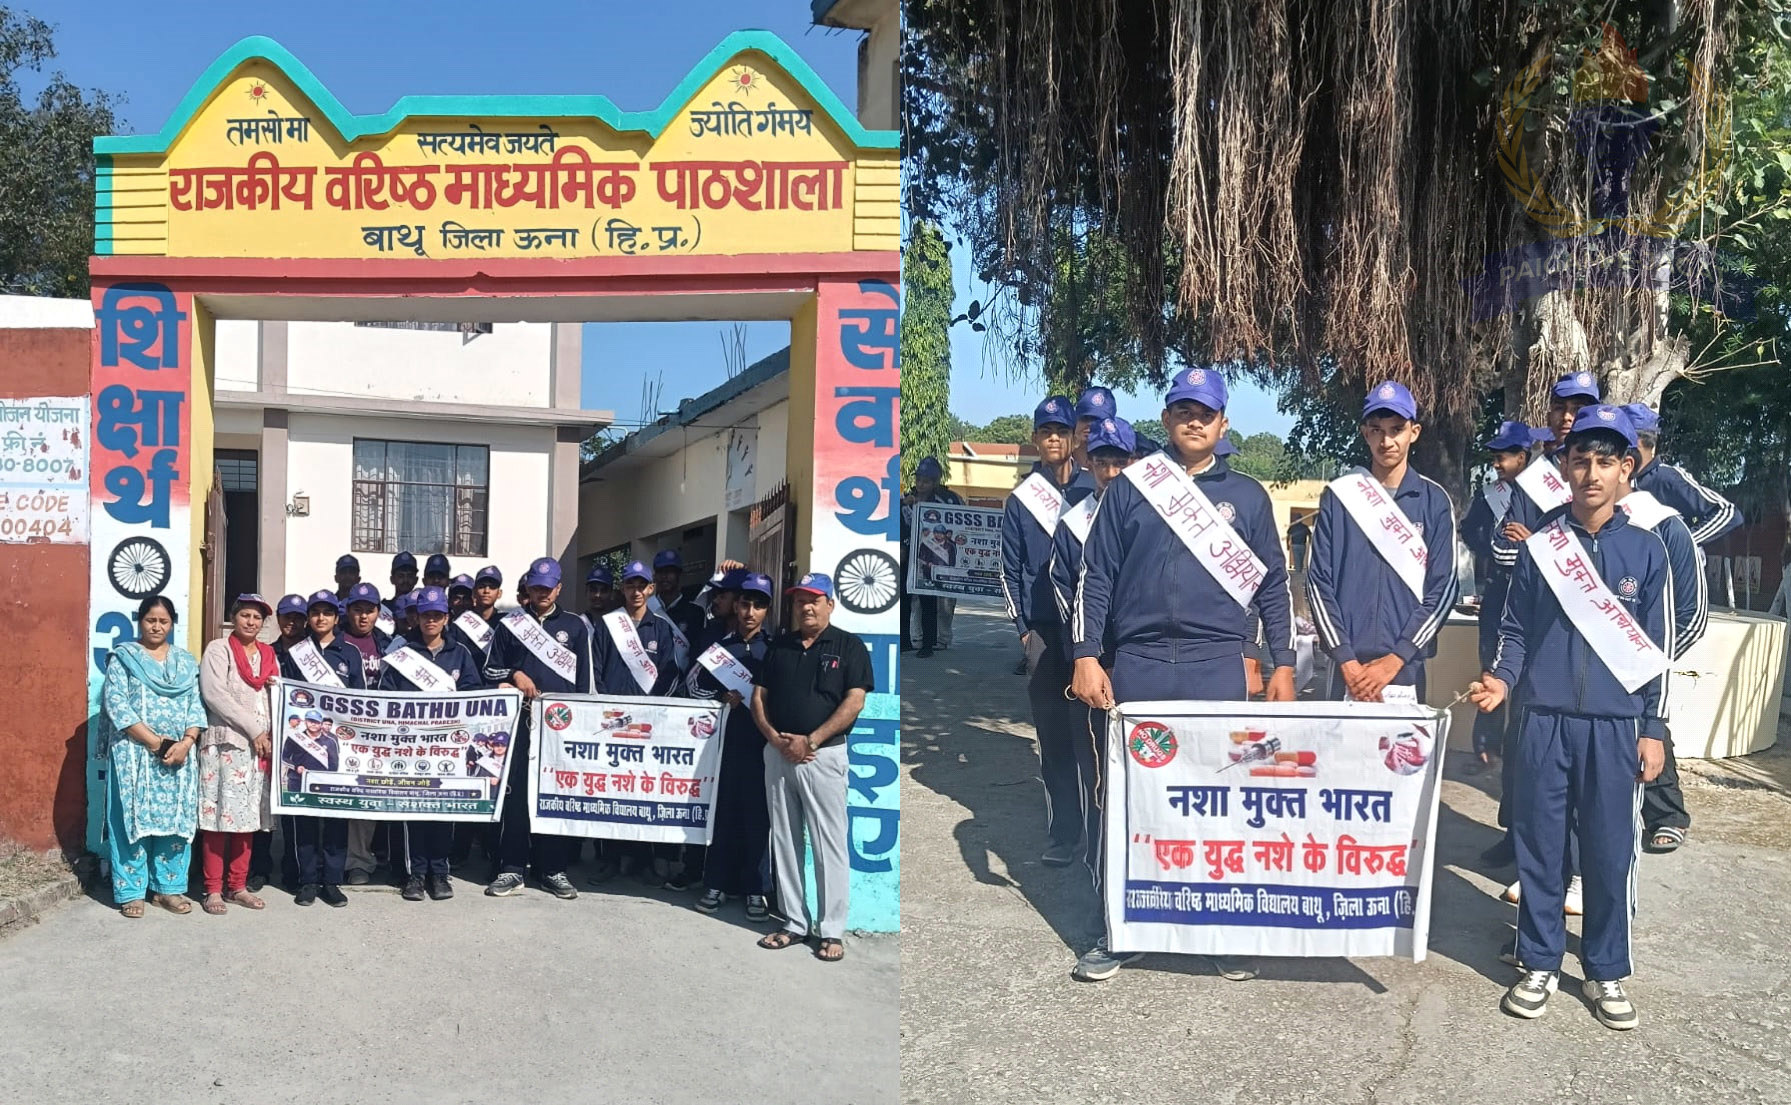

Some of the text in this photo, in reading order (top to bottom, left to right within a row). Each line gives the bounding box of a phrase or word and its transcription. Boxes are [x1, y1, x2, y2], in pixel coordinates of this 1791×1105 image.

[417, 124, 560, 156] सत्यमेव जयते
[169, 145, 850, 211] राजकीय वरिष्ठ माध्यमिक पाठशाला
[361, 224, 431, 258] बाथू
[439, 220, 505, 250] जिला
[513, 228, 580, 251] ऊना
[16, 495, 70, 513] CODE
[1357, 477, 1387, 507] नशा
[945, 512, 982, 527] GSSS
[319, 694, 379, 718] GSSS
[386, 701, 459, 719] BATHU
[465, 699, 508, 717] UNA
[361, 731, 448, 746] नशा मुक्त भारत
[394, 743, 414, 756] नशे
[416, 745, 428, 757] के
[564, 741, 695, 767] नशा मुक्त भारत
[582, 771, 607, 795] युद्ध
[611, 770, 636, 792] नशे
[640, 771, 656, 793] के
[317, 796, 352, 807] स्वस्थ
[358, 798, 383, 809] युवा
[445, 800, 478, 810] भारत
[1166, 786, 1393, 828] नशा मुक्त भारत
[1203, 839, 1246, 880] युद्ध
[1252, 832, 1294, 872] नशे
[1302, 833, 1329, 873] के
[1173, 887, 1202, 912] वरिष्ठ
[1205, 887, 1254, 914] माध्यमिक
[1257, 888, 1299, 915] विद्यालय
[1366, 897, 1390, 917] ऊना
